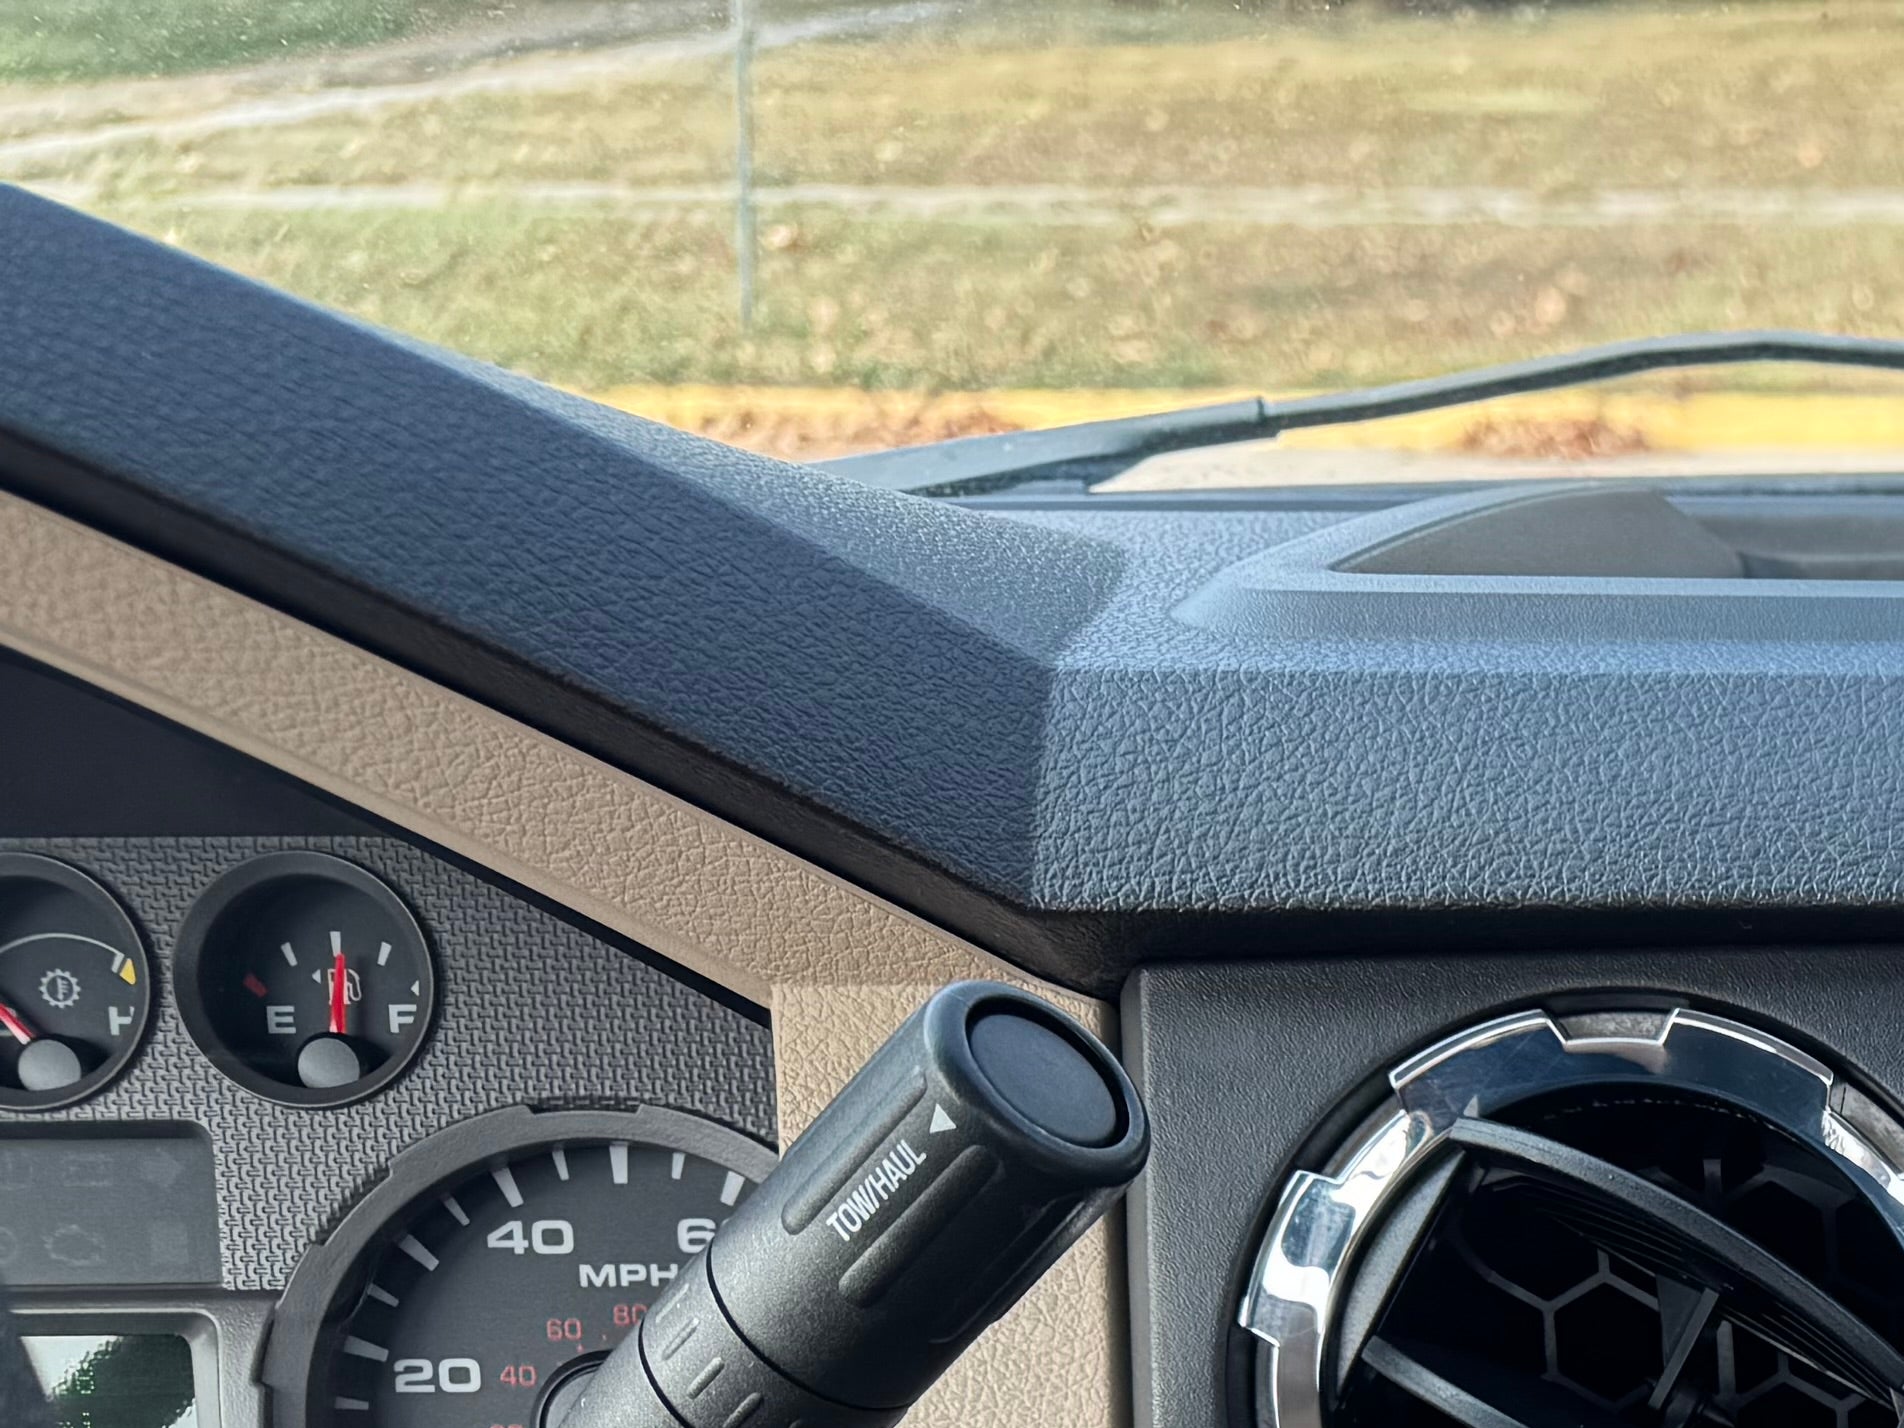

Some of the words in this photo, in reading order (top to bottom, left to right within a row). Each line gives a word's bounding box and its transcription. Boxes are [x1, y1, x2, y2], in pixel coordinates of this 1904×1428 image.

[266, 1005, 296, 1034] E
[389, 1004, 417, 1033] F
[826, 1140, 927, 1242] TOW/HAUL
[487, 1220, 574, 1254] 40
[578, 1263, 679, 1288] MPH
[546, 1317, 583, 1342] 60
[393, 1358, 482, 1393] 20
[500, 1366, 536, 1386] 40
